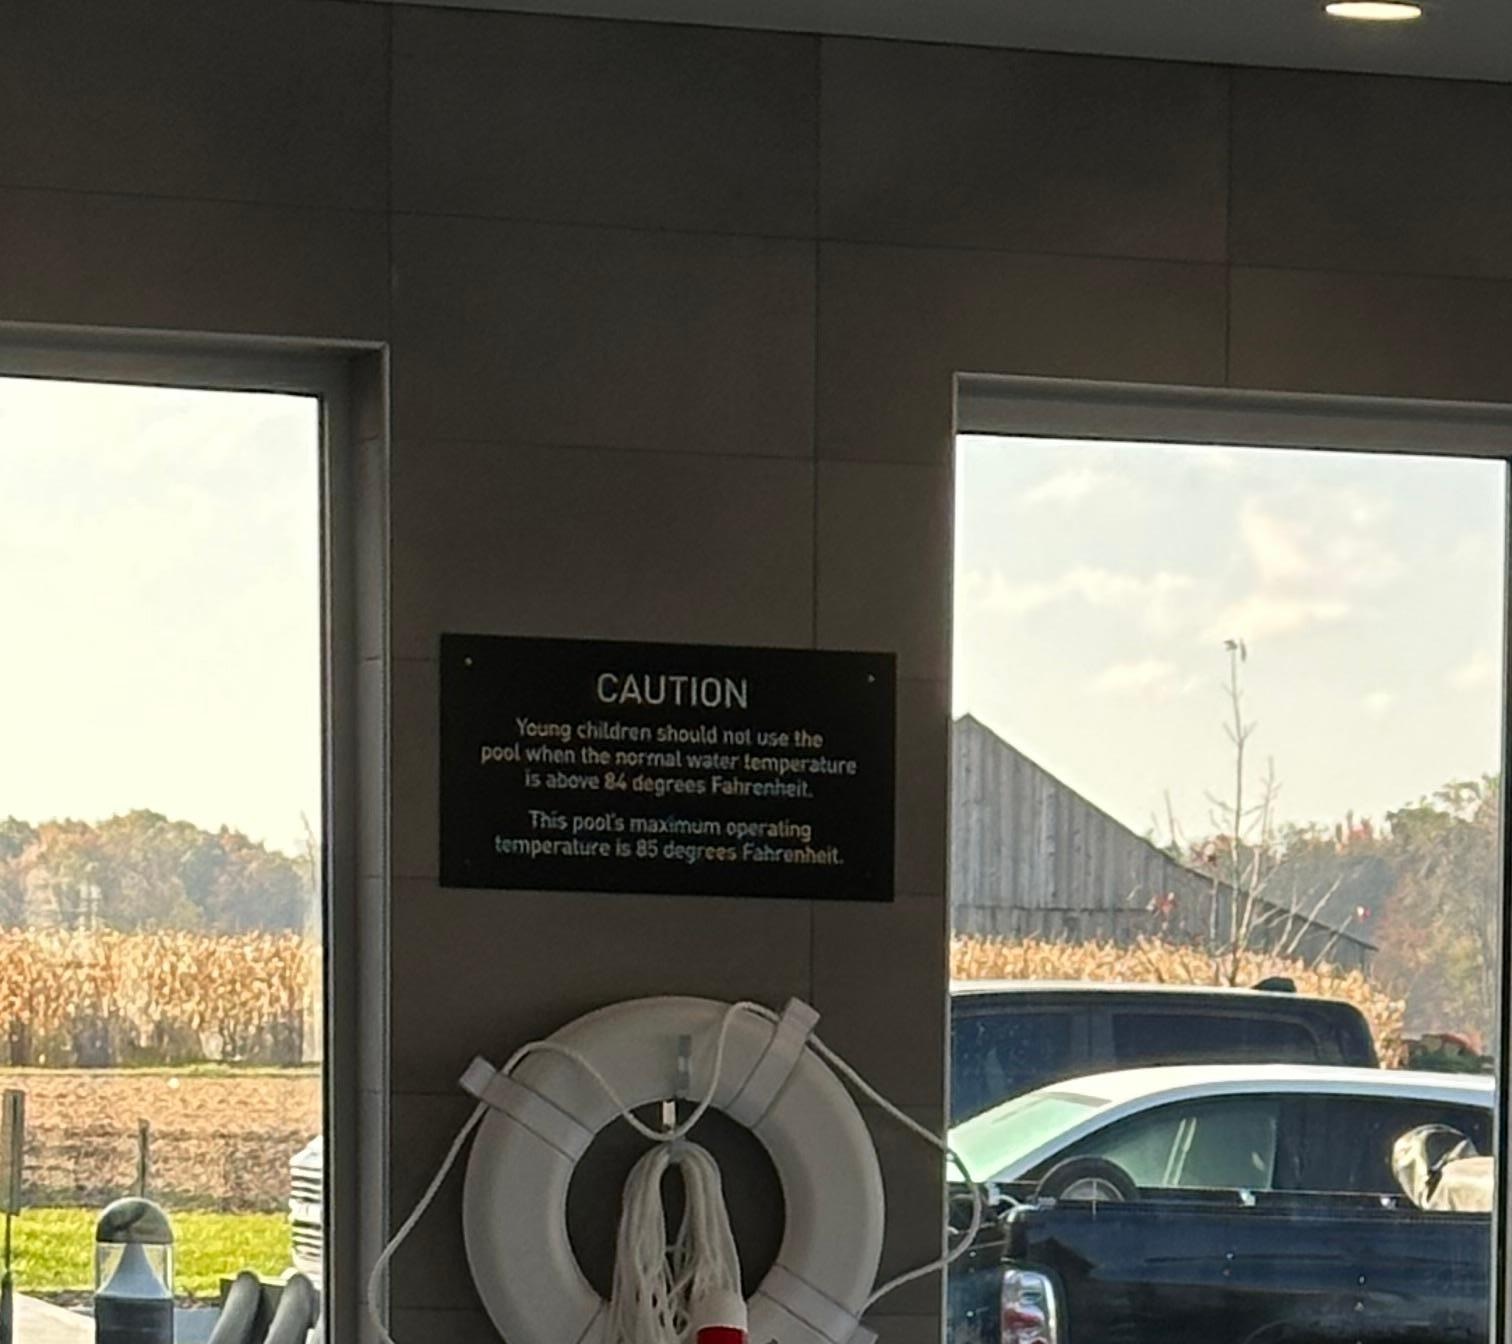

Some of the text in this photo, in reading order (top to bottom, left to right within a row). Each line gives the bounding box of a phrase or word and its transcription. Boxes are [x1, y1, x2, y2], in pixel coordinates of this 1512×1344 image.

[597, 673, 748, 709] CAUTION
[516, 717, 824, 748] Young children should not use the
[481, 743, 857, 775] pool when the normal water temperature
[525, 769, 814, 798] is above 84 degrees Fahrenheit.
[528, 809, 812, 841] This pool's maximum operating
[495, 835, 844, 865] temperature is 85 degrees Fahrenheit.
